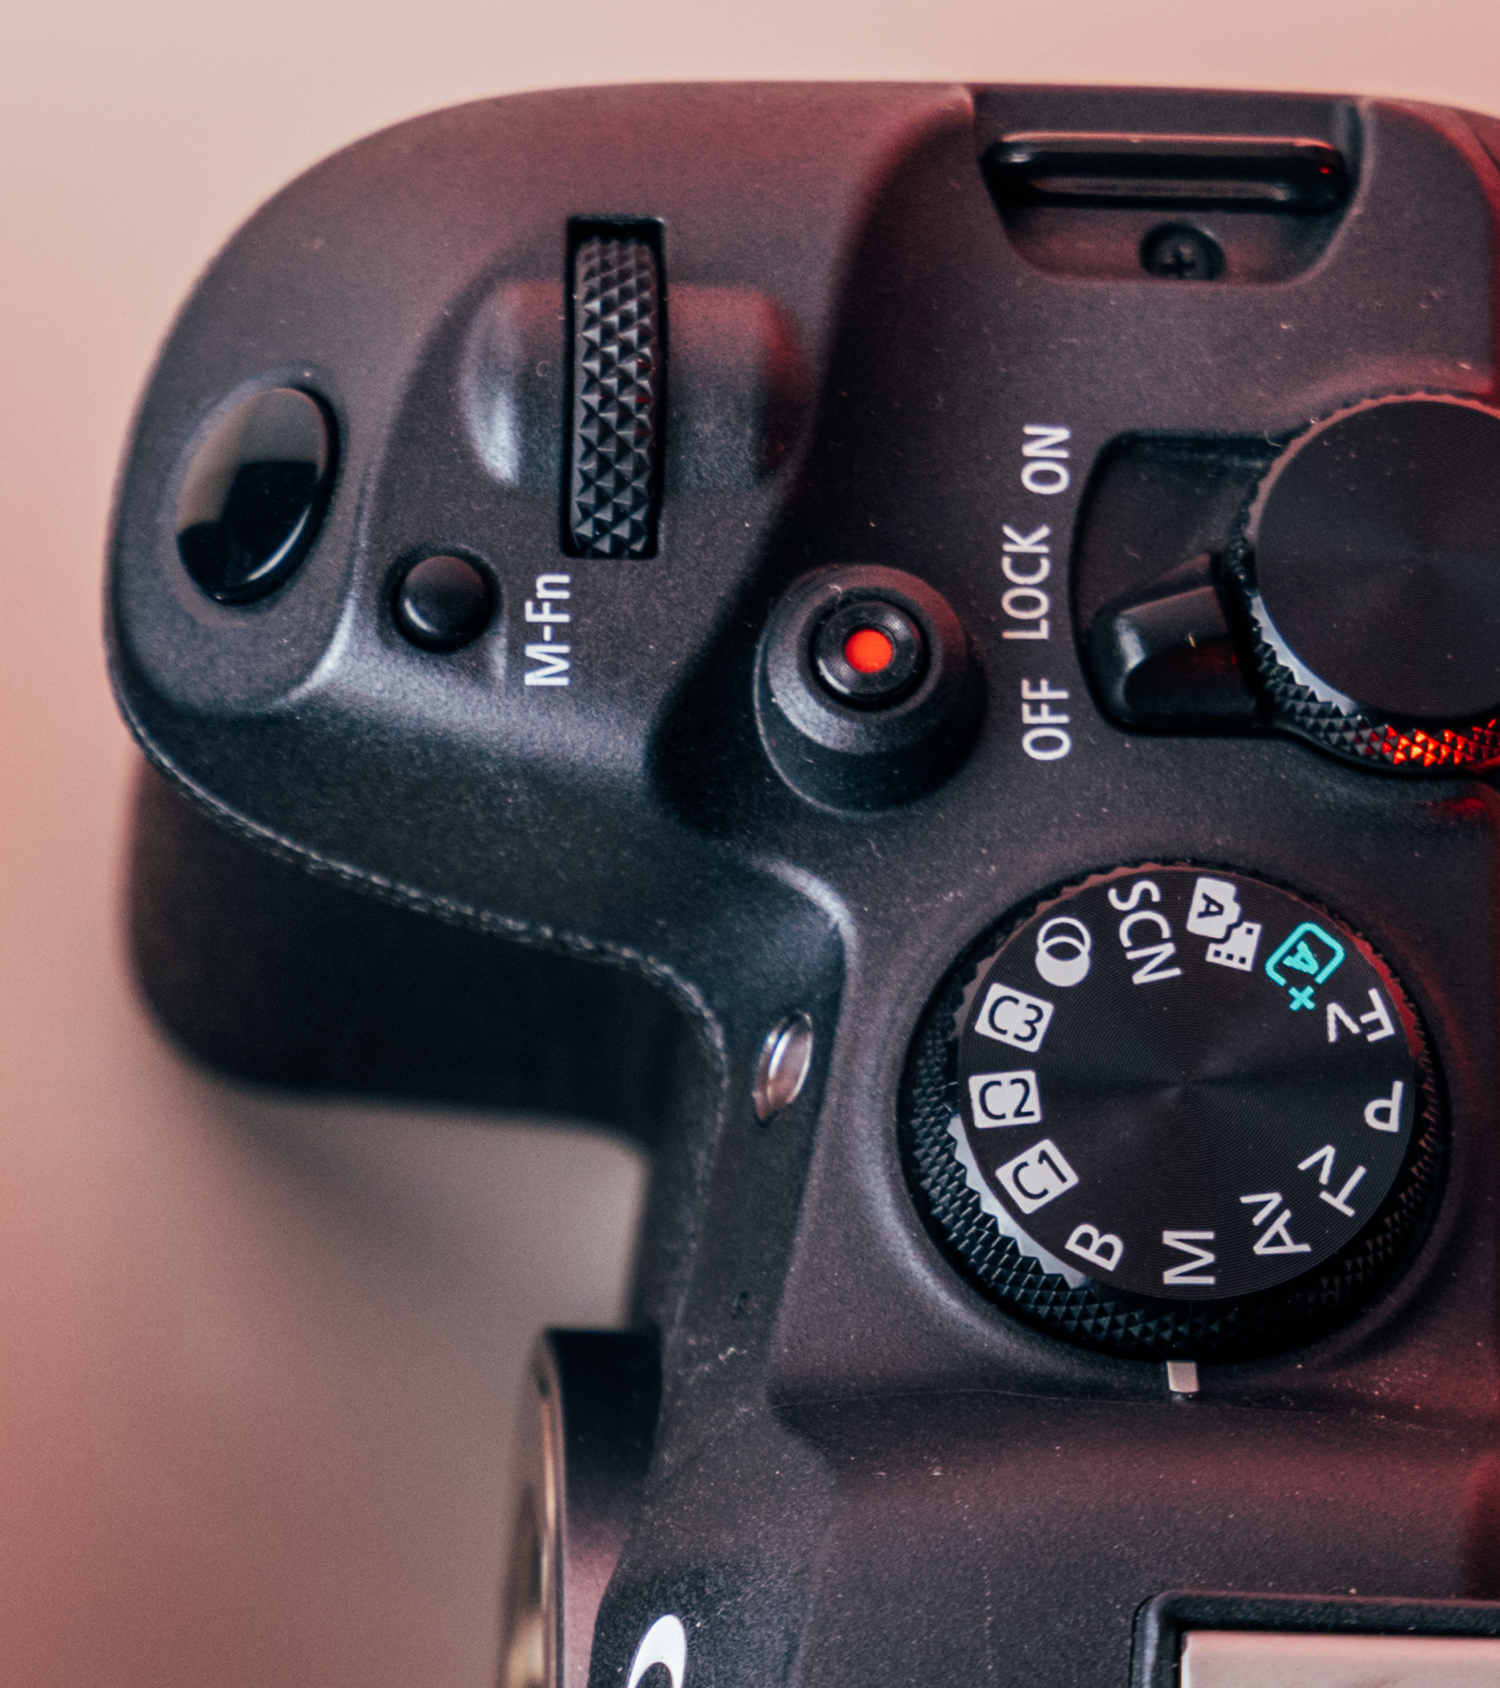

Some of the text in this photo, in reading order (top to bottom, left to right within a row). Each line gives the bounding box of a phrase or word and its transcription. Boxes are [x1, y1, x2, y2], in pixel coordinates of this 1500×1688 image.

[1020, 424, 1072, 495] ON
[1001, 524, 1052, 640] LOCK
[523, 573, 571, 687] M-Fn
[1021, 678, 1073, 762] OFF
[1107, 879, 1182, 985] SCN
[986, 993, 1046, 1044] C3
[978, 1077, 1035, 1121] C2
[1363, 1080, 1404, 1133] P
[1010, 1149, 1068, 1201] C1
[1064, 1223, 1126, 1273] B
[1162, 1230, 1216, 1286] M
